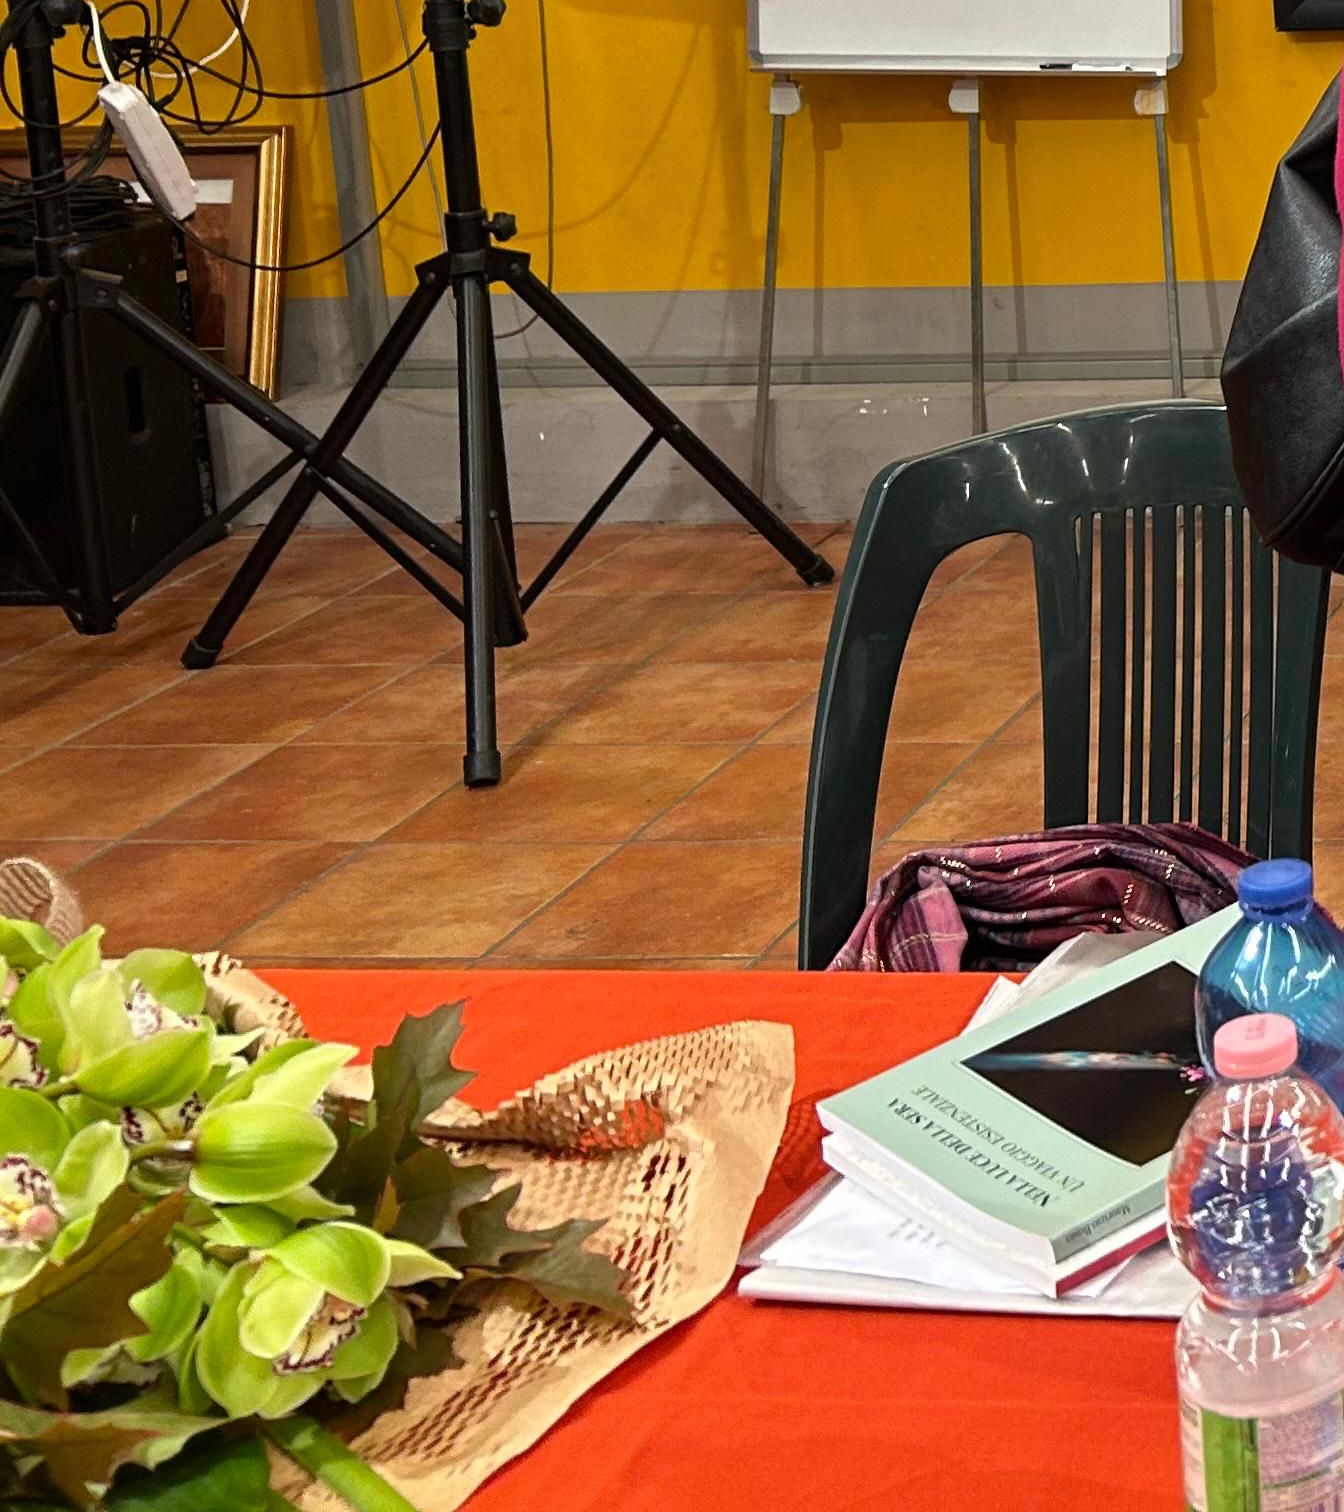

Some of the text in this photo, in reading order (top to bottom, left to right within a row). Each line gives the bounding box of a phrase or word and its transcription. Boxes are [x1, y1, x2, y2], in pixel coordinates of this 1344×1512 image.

[887, 1097, 1057, 1208] NELLA LUCE DELLA SERA
[911, 1084, 1086, 1193] UN VIAGGIO ESISTENZIALE
